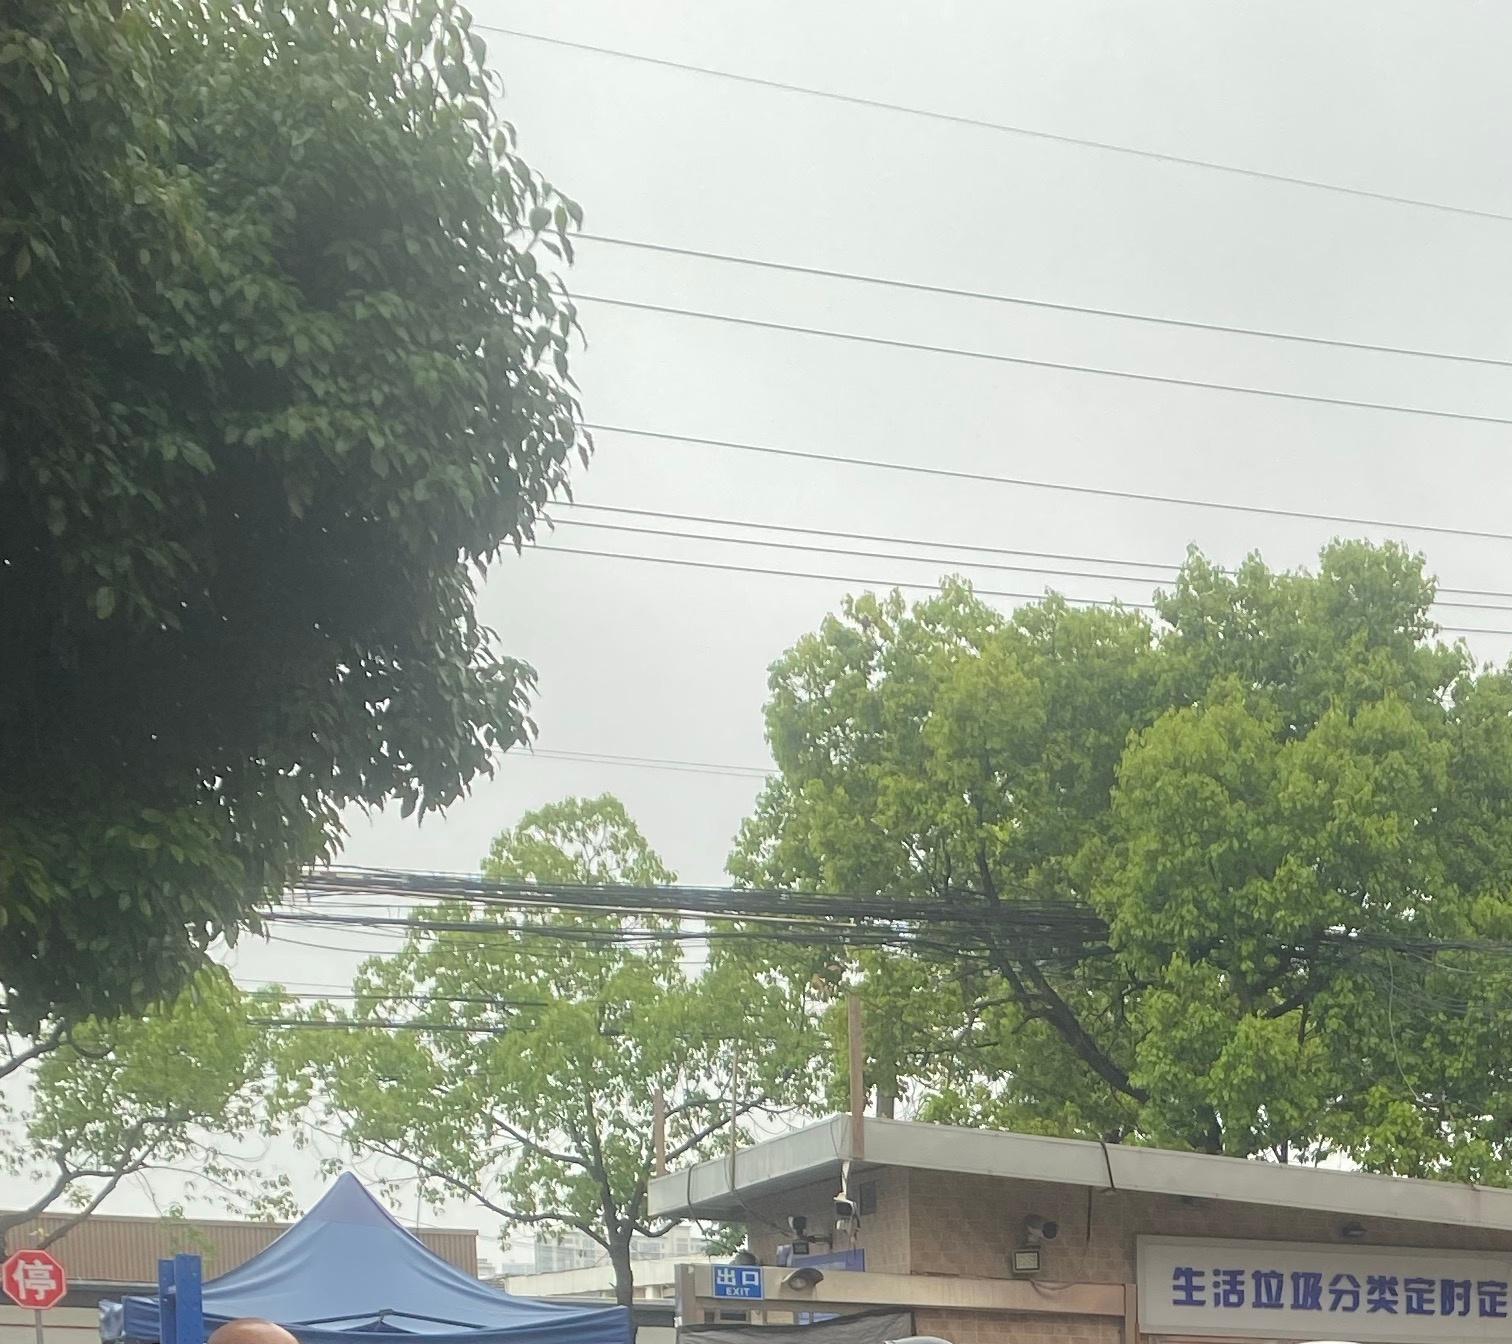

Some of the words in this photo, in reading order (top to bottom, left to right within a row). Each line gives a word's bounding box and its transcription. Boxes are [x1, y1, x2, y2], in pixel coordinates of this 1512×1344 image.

[12, 1259, 57, 1301] 停
[716, 1267, 760, 1286] 出口
[725, 1286, 751, 1297] EXIT
